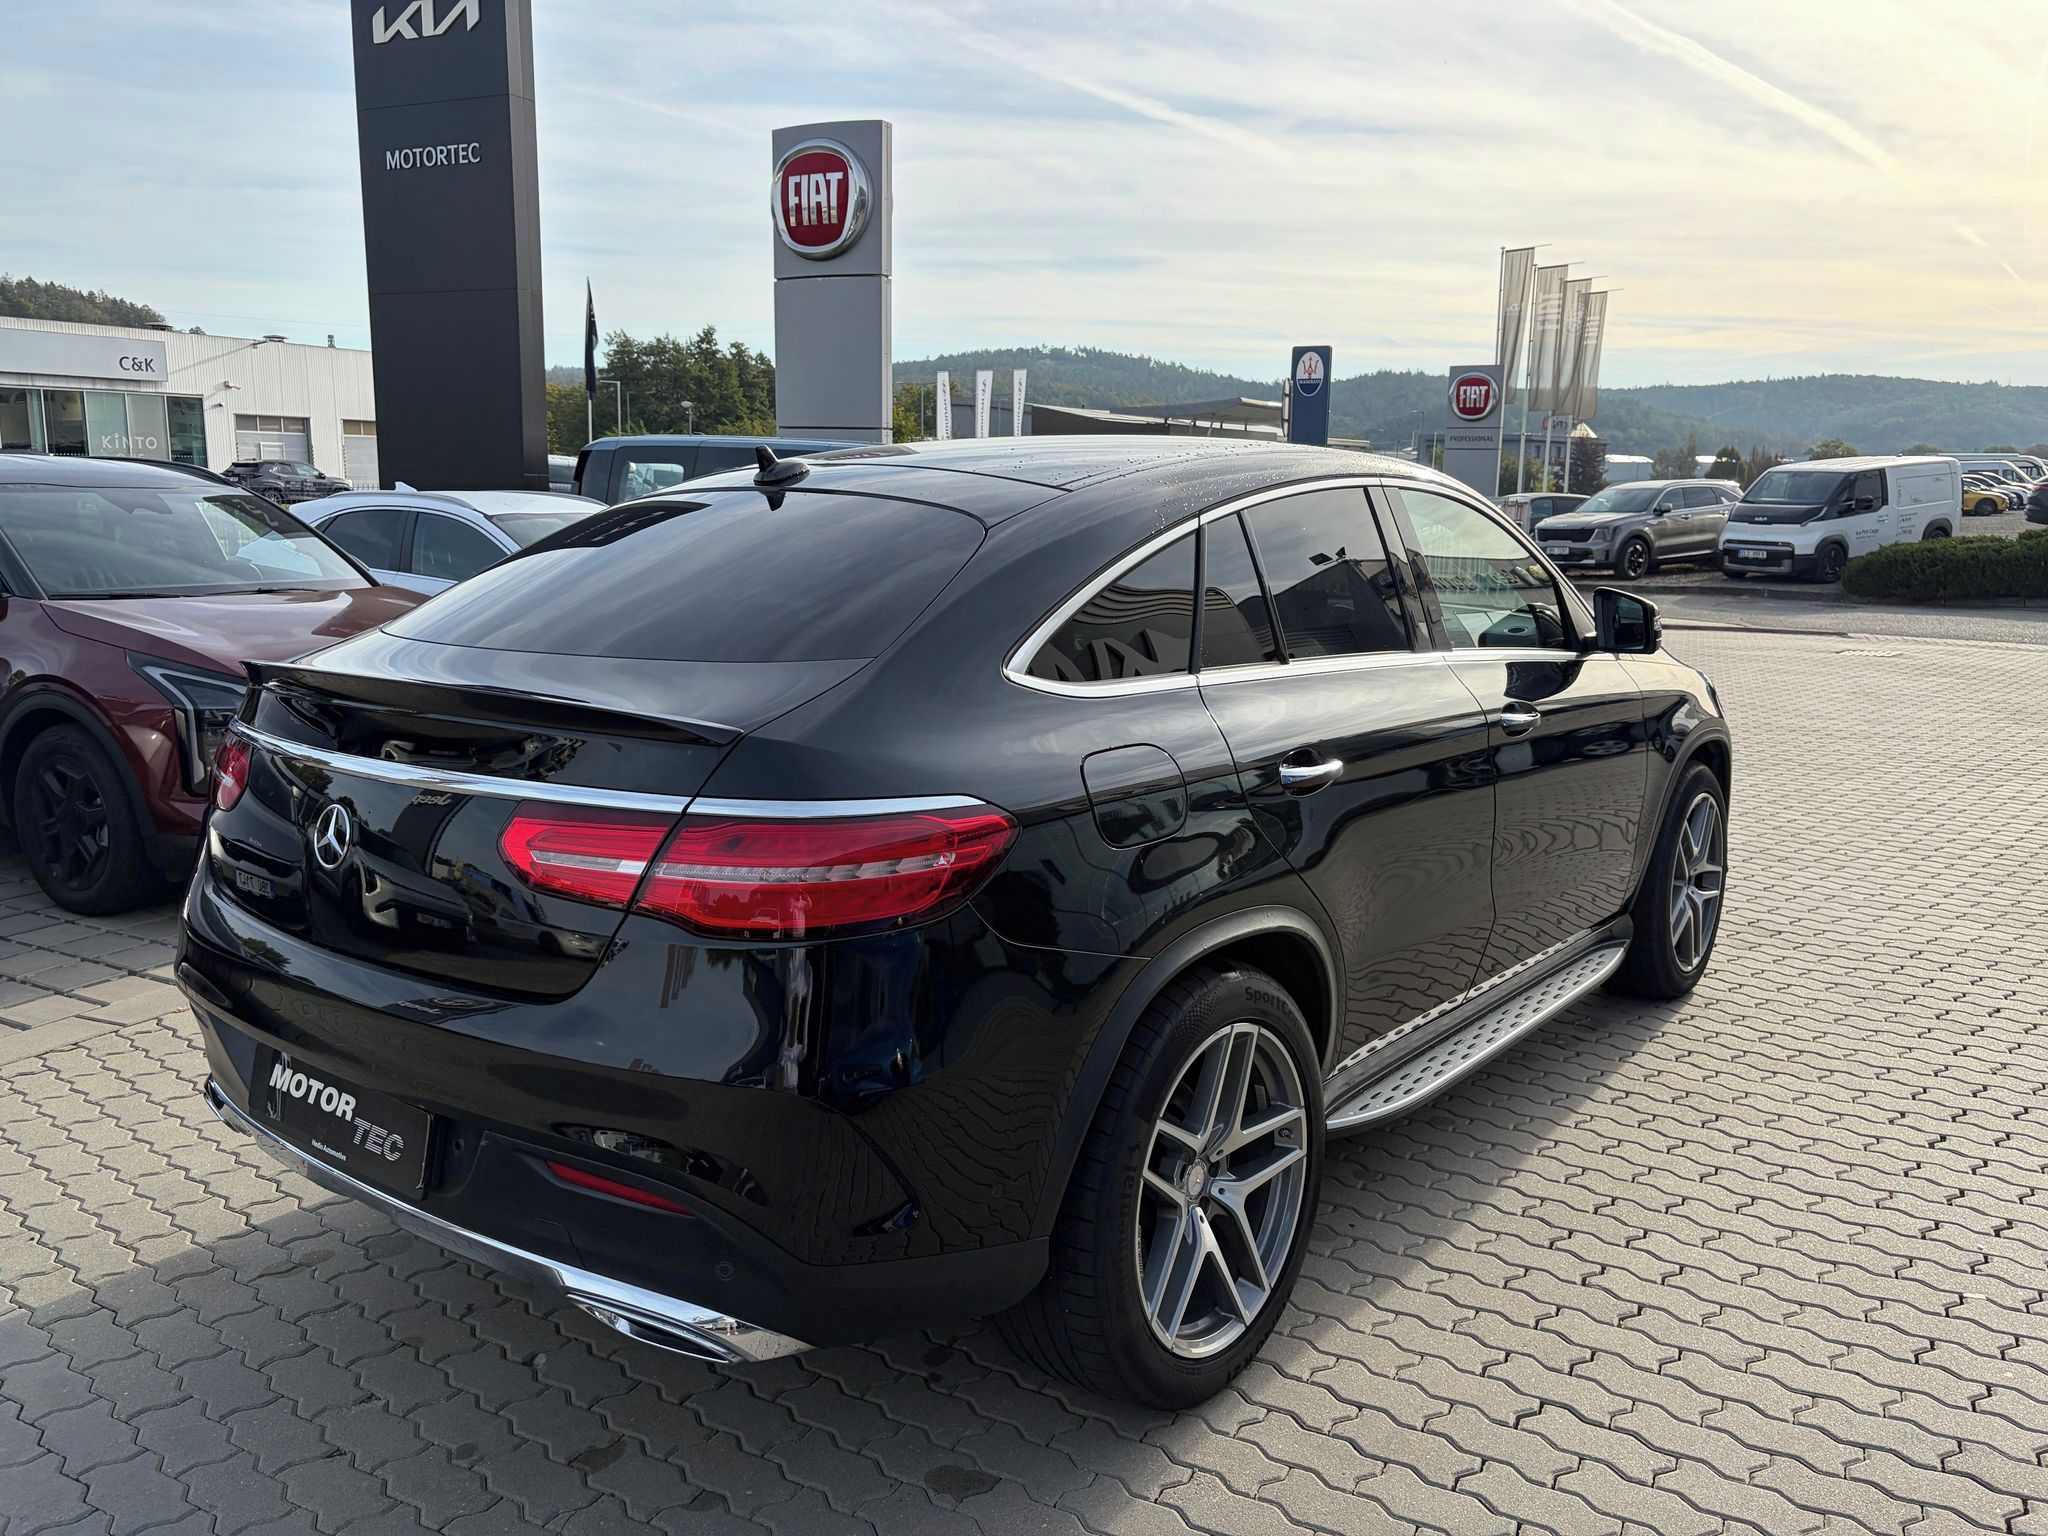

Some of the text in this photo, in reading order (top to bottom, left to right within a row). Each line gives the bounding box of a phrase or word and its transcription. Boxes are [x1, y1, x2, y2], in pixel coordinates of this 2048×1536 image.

[372, 0, 481, 44] KIA
[386, 142, 481, 171] MOTORTEC
[788, 171, 844, 227] FIAT
[118, 356, 156, 373] C&K
[1459, 385, 1489, 408] FIAT
[1449, 435, 1494, 443] PROFESSIONAL
[269, 1063, 357, 1122] MOTOR
[353, 1117, 405, 1162] TEC
